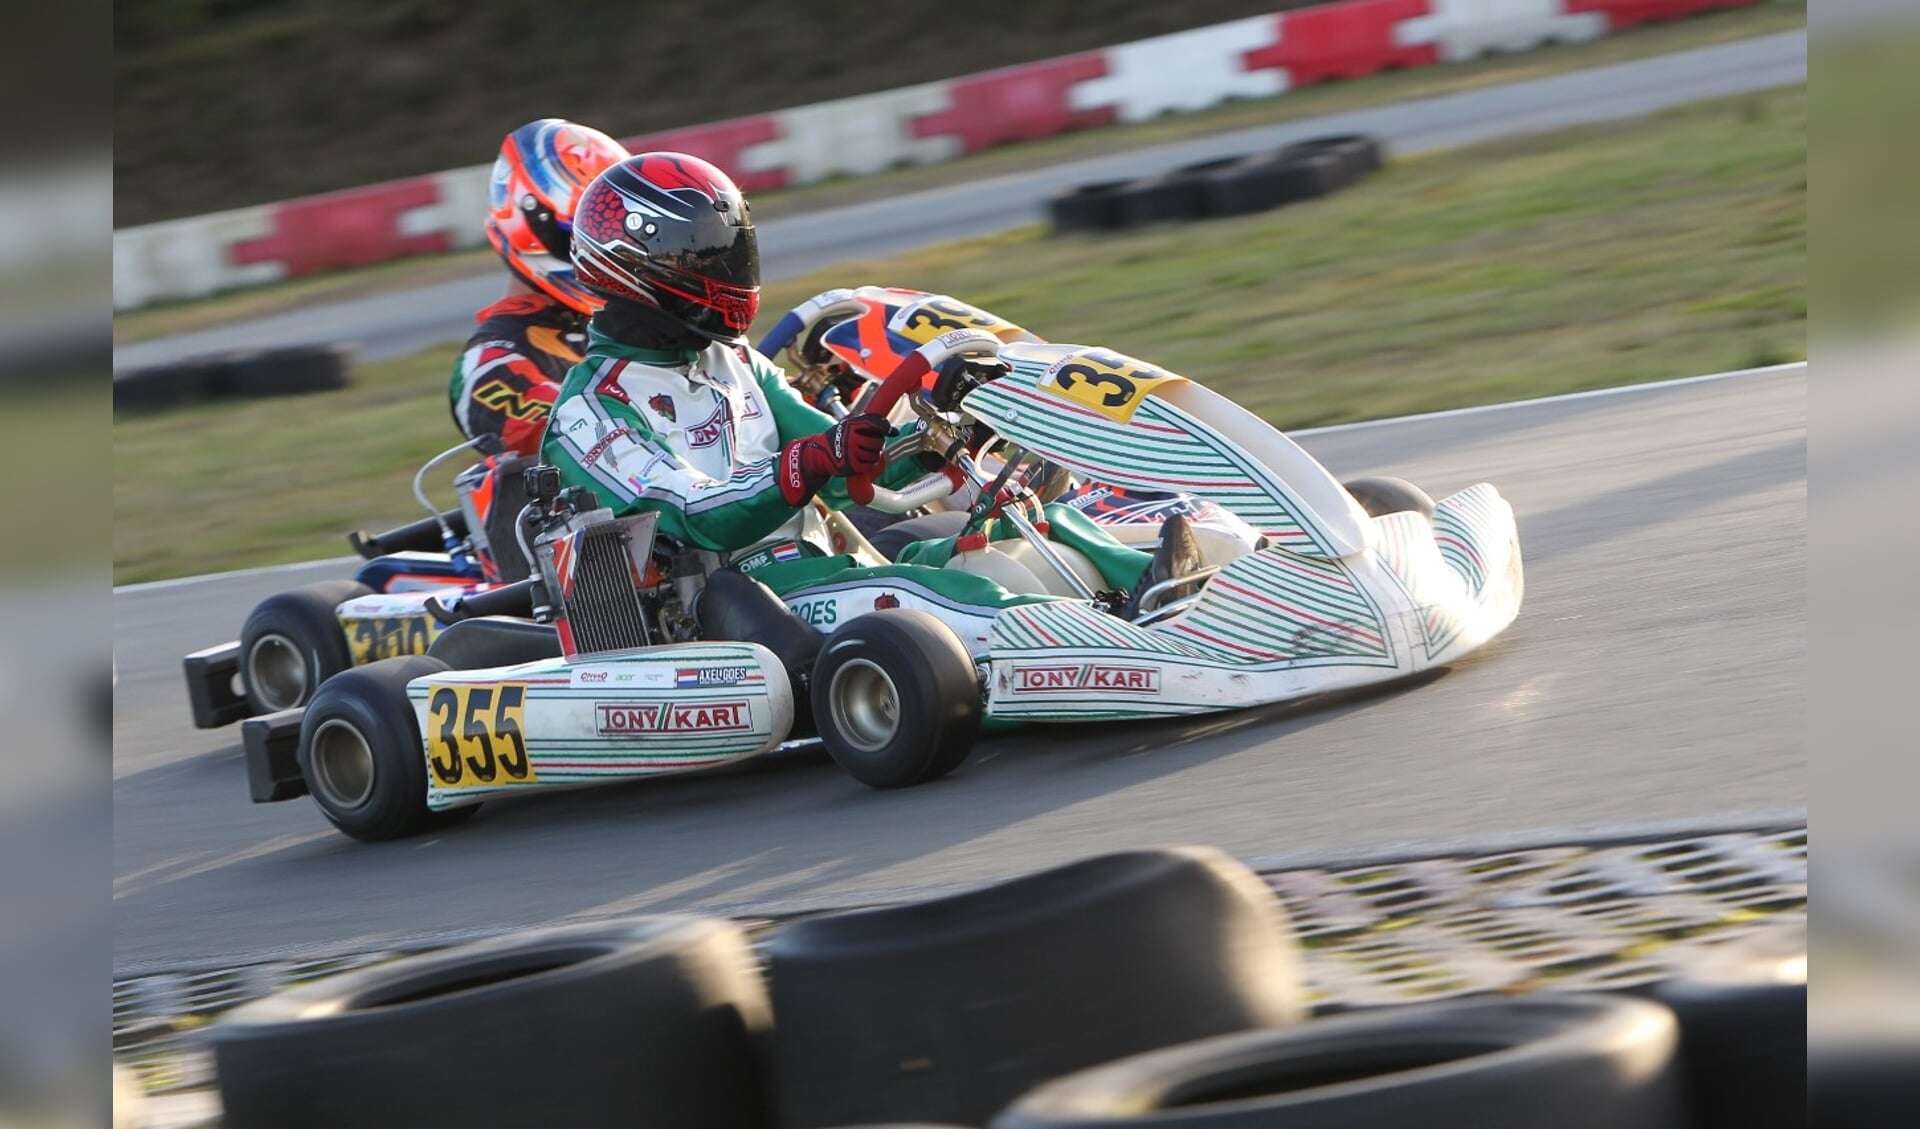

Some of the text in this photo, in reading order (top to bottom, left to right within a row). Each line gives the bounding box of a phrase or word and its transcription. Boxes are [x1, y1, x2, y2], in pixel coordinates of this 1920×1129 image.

[740, 554, 768, 573] OMP
[700, 667, 746, 682] AXEL GOES
[1095, 667, 1157, 688] KART
[674, 702, 747, 728] KART
[430, 686, 529, 784] 355
